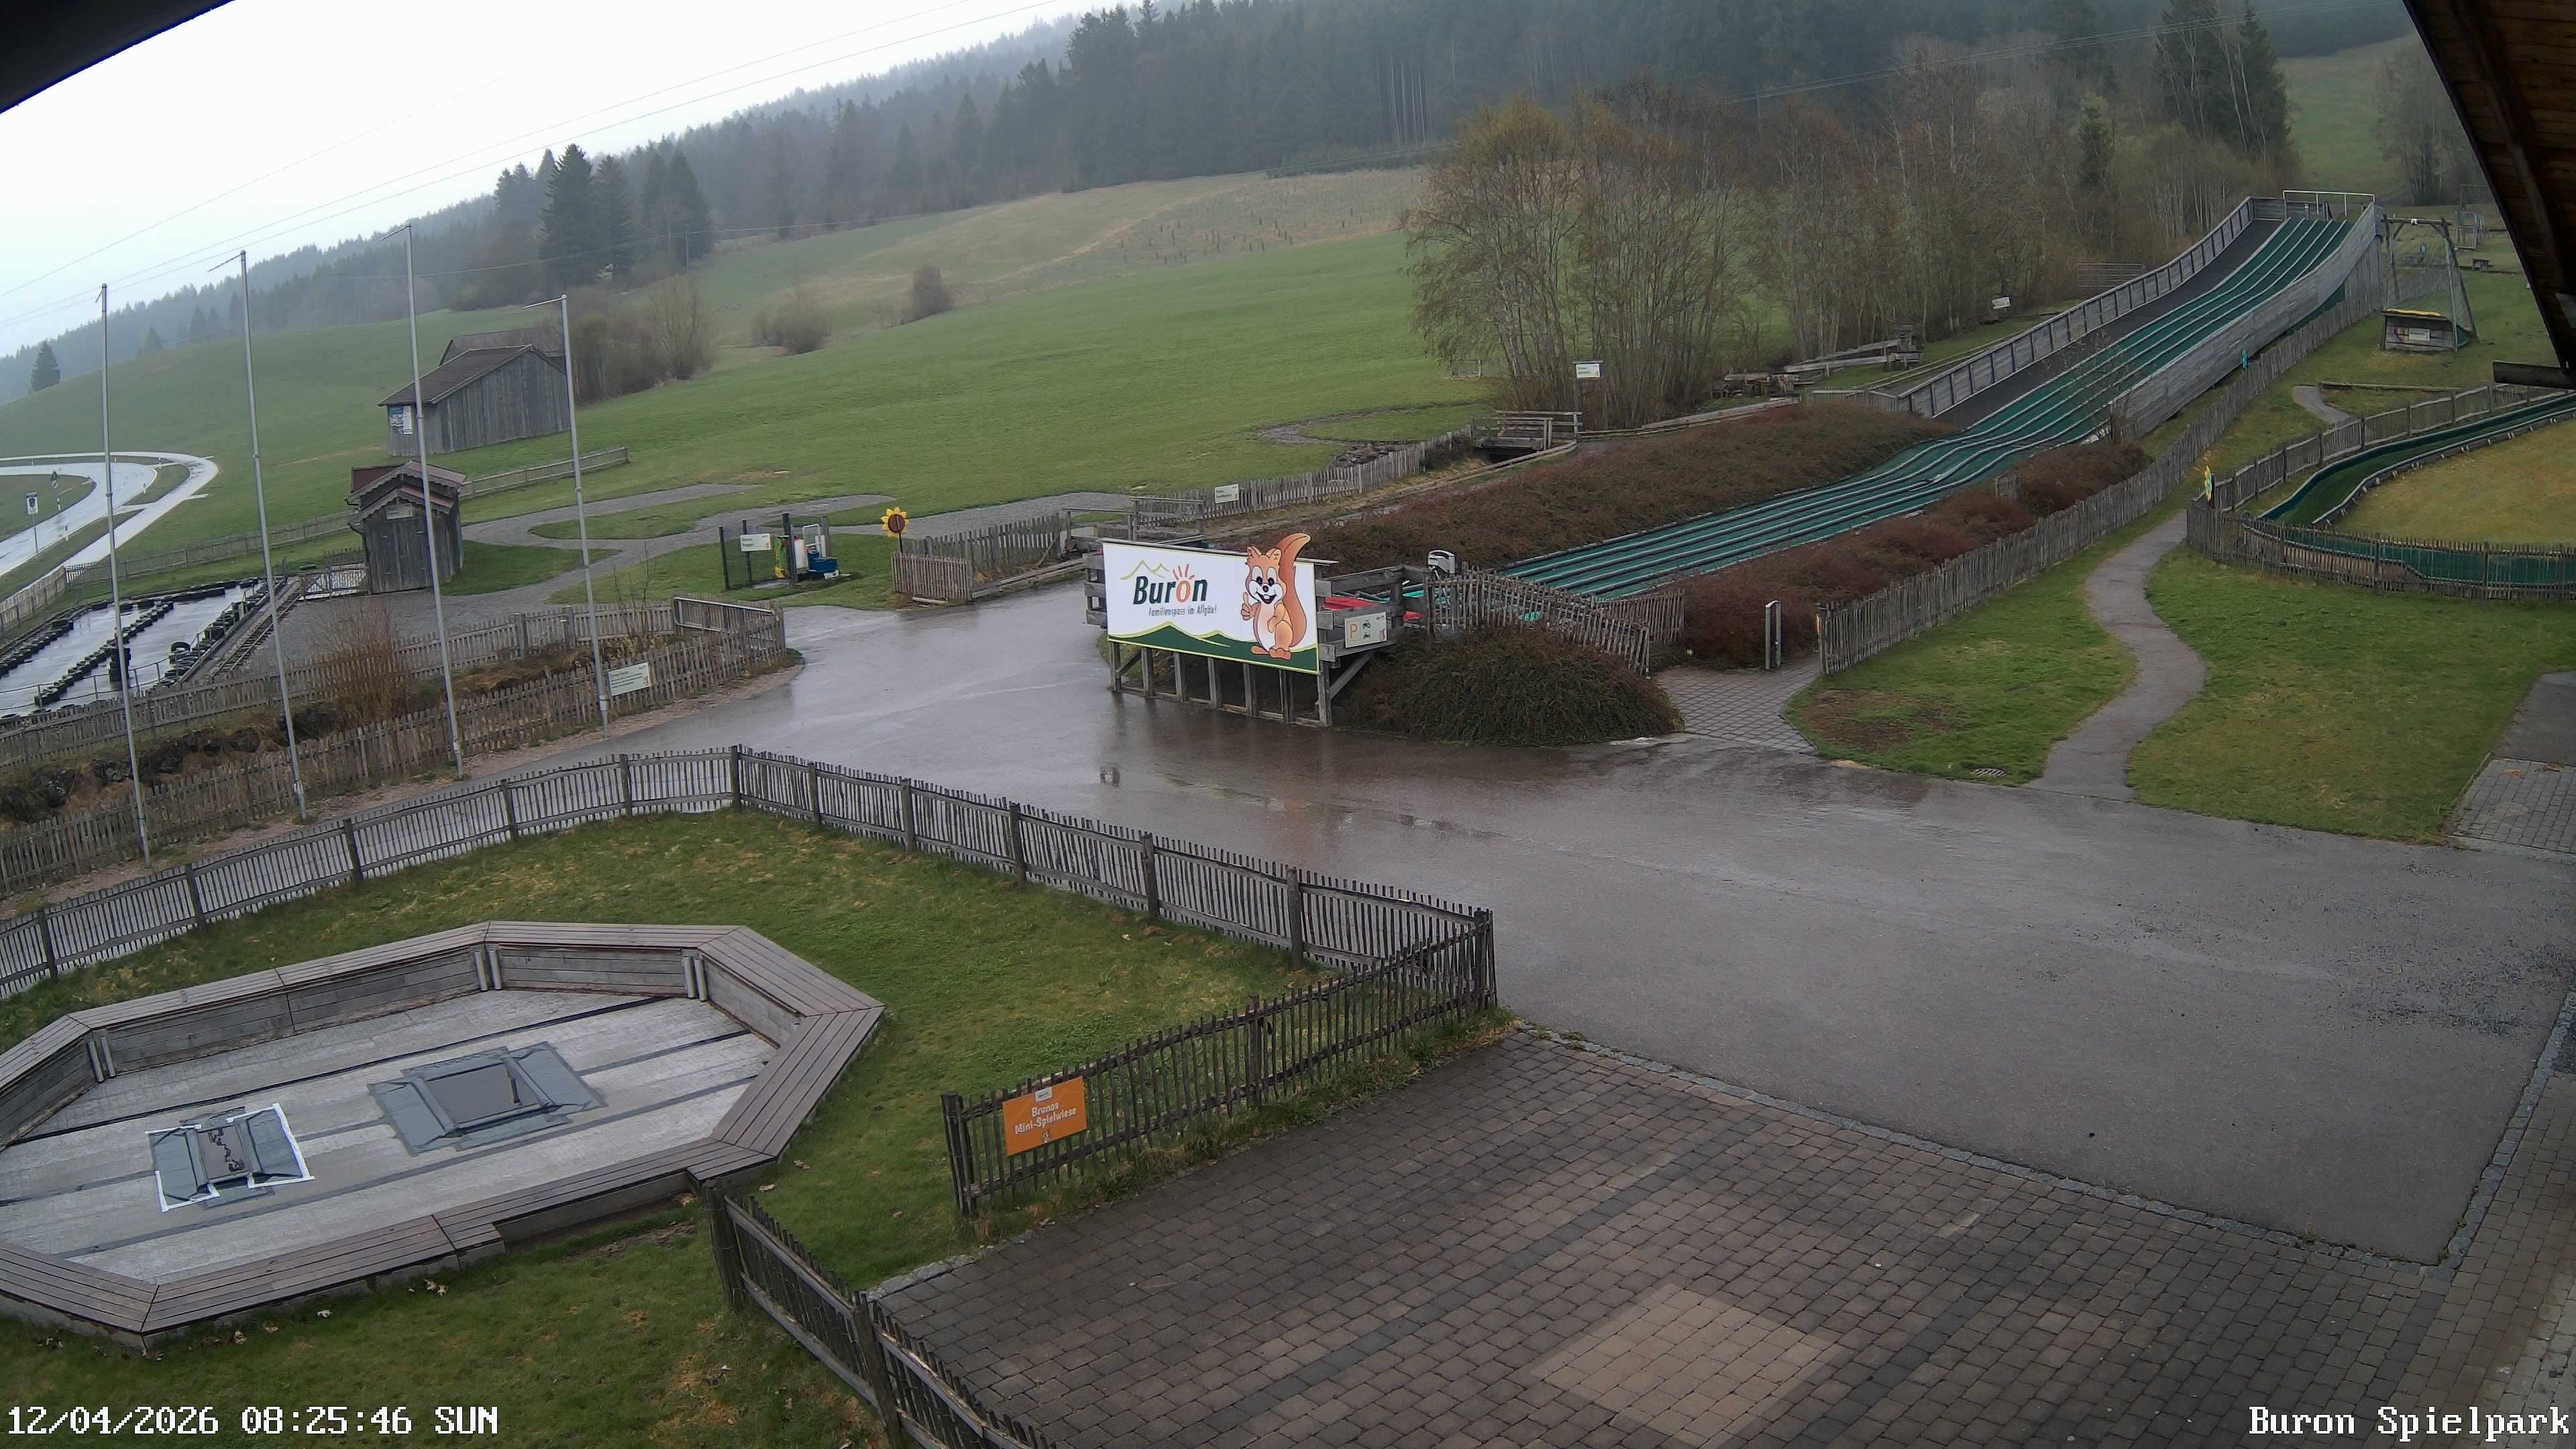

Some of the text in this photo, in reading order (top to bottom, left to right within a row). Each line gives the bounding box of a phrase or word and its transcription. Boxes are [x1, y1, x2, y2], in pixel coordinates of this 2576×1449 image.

[1132, 575, 1208, 605] Buron
[1187, 606, 1195, 614] im
[1350, 623, 1358, 639] P
[1014, 1108, 1077, 1134] Mini-Spielwiese
